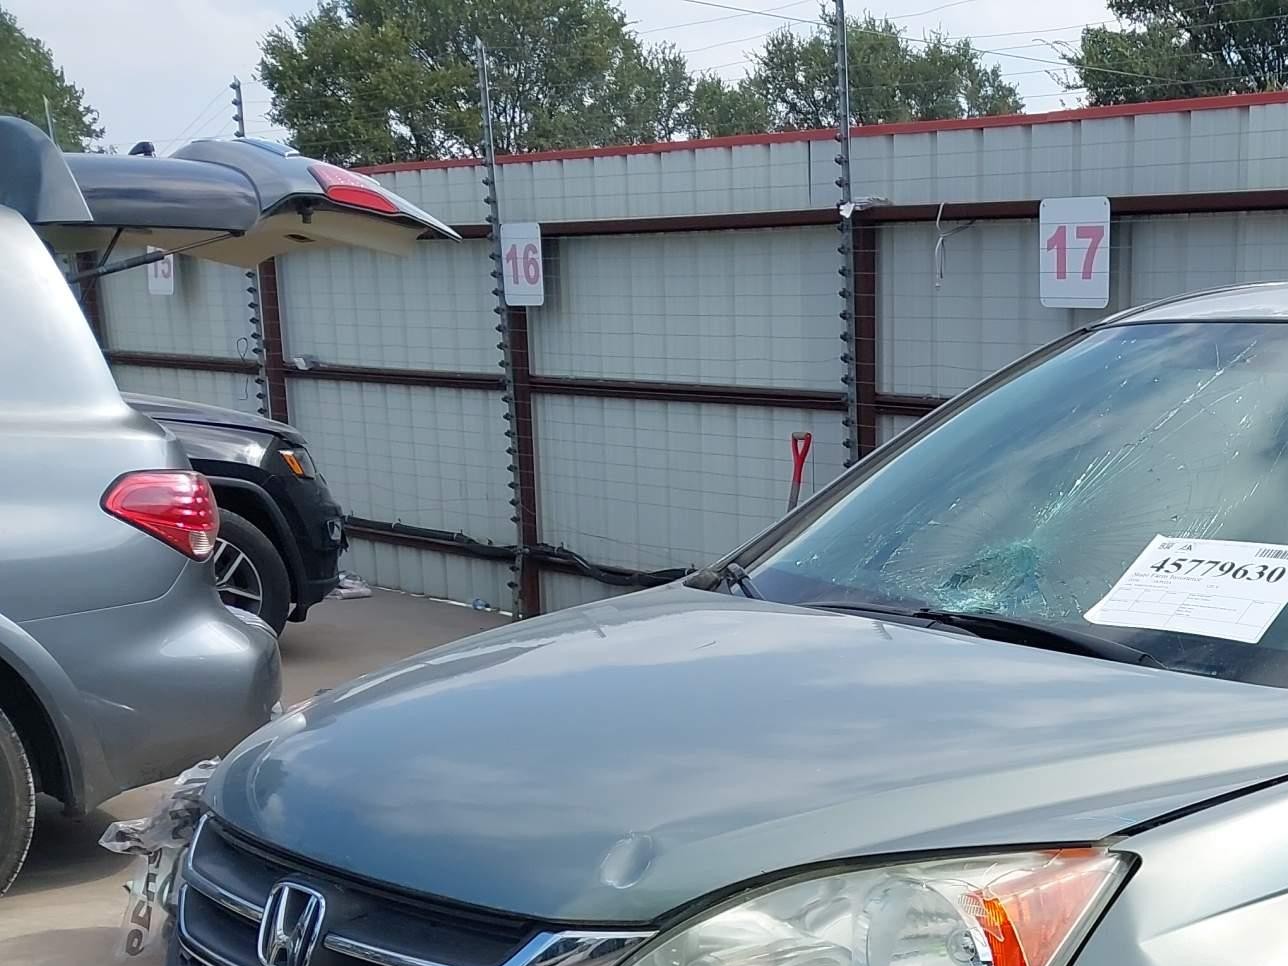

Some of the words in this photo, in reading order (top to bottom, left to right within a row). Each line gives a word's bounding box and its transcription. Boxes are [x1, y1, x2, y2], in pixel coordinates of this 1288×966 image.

[505, 243, 540, 285] 16
[1046, 225, 1105, 280] 17
[1150, 556, 1286, 583] 45779630
